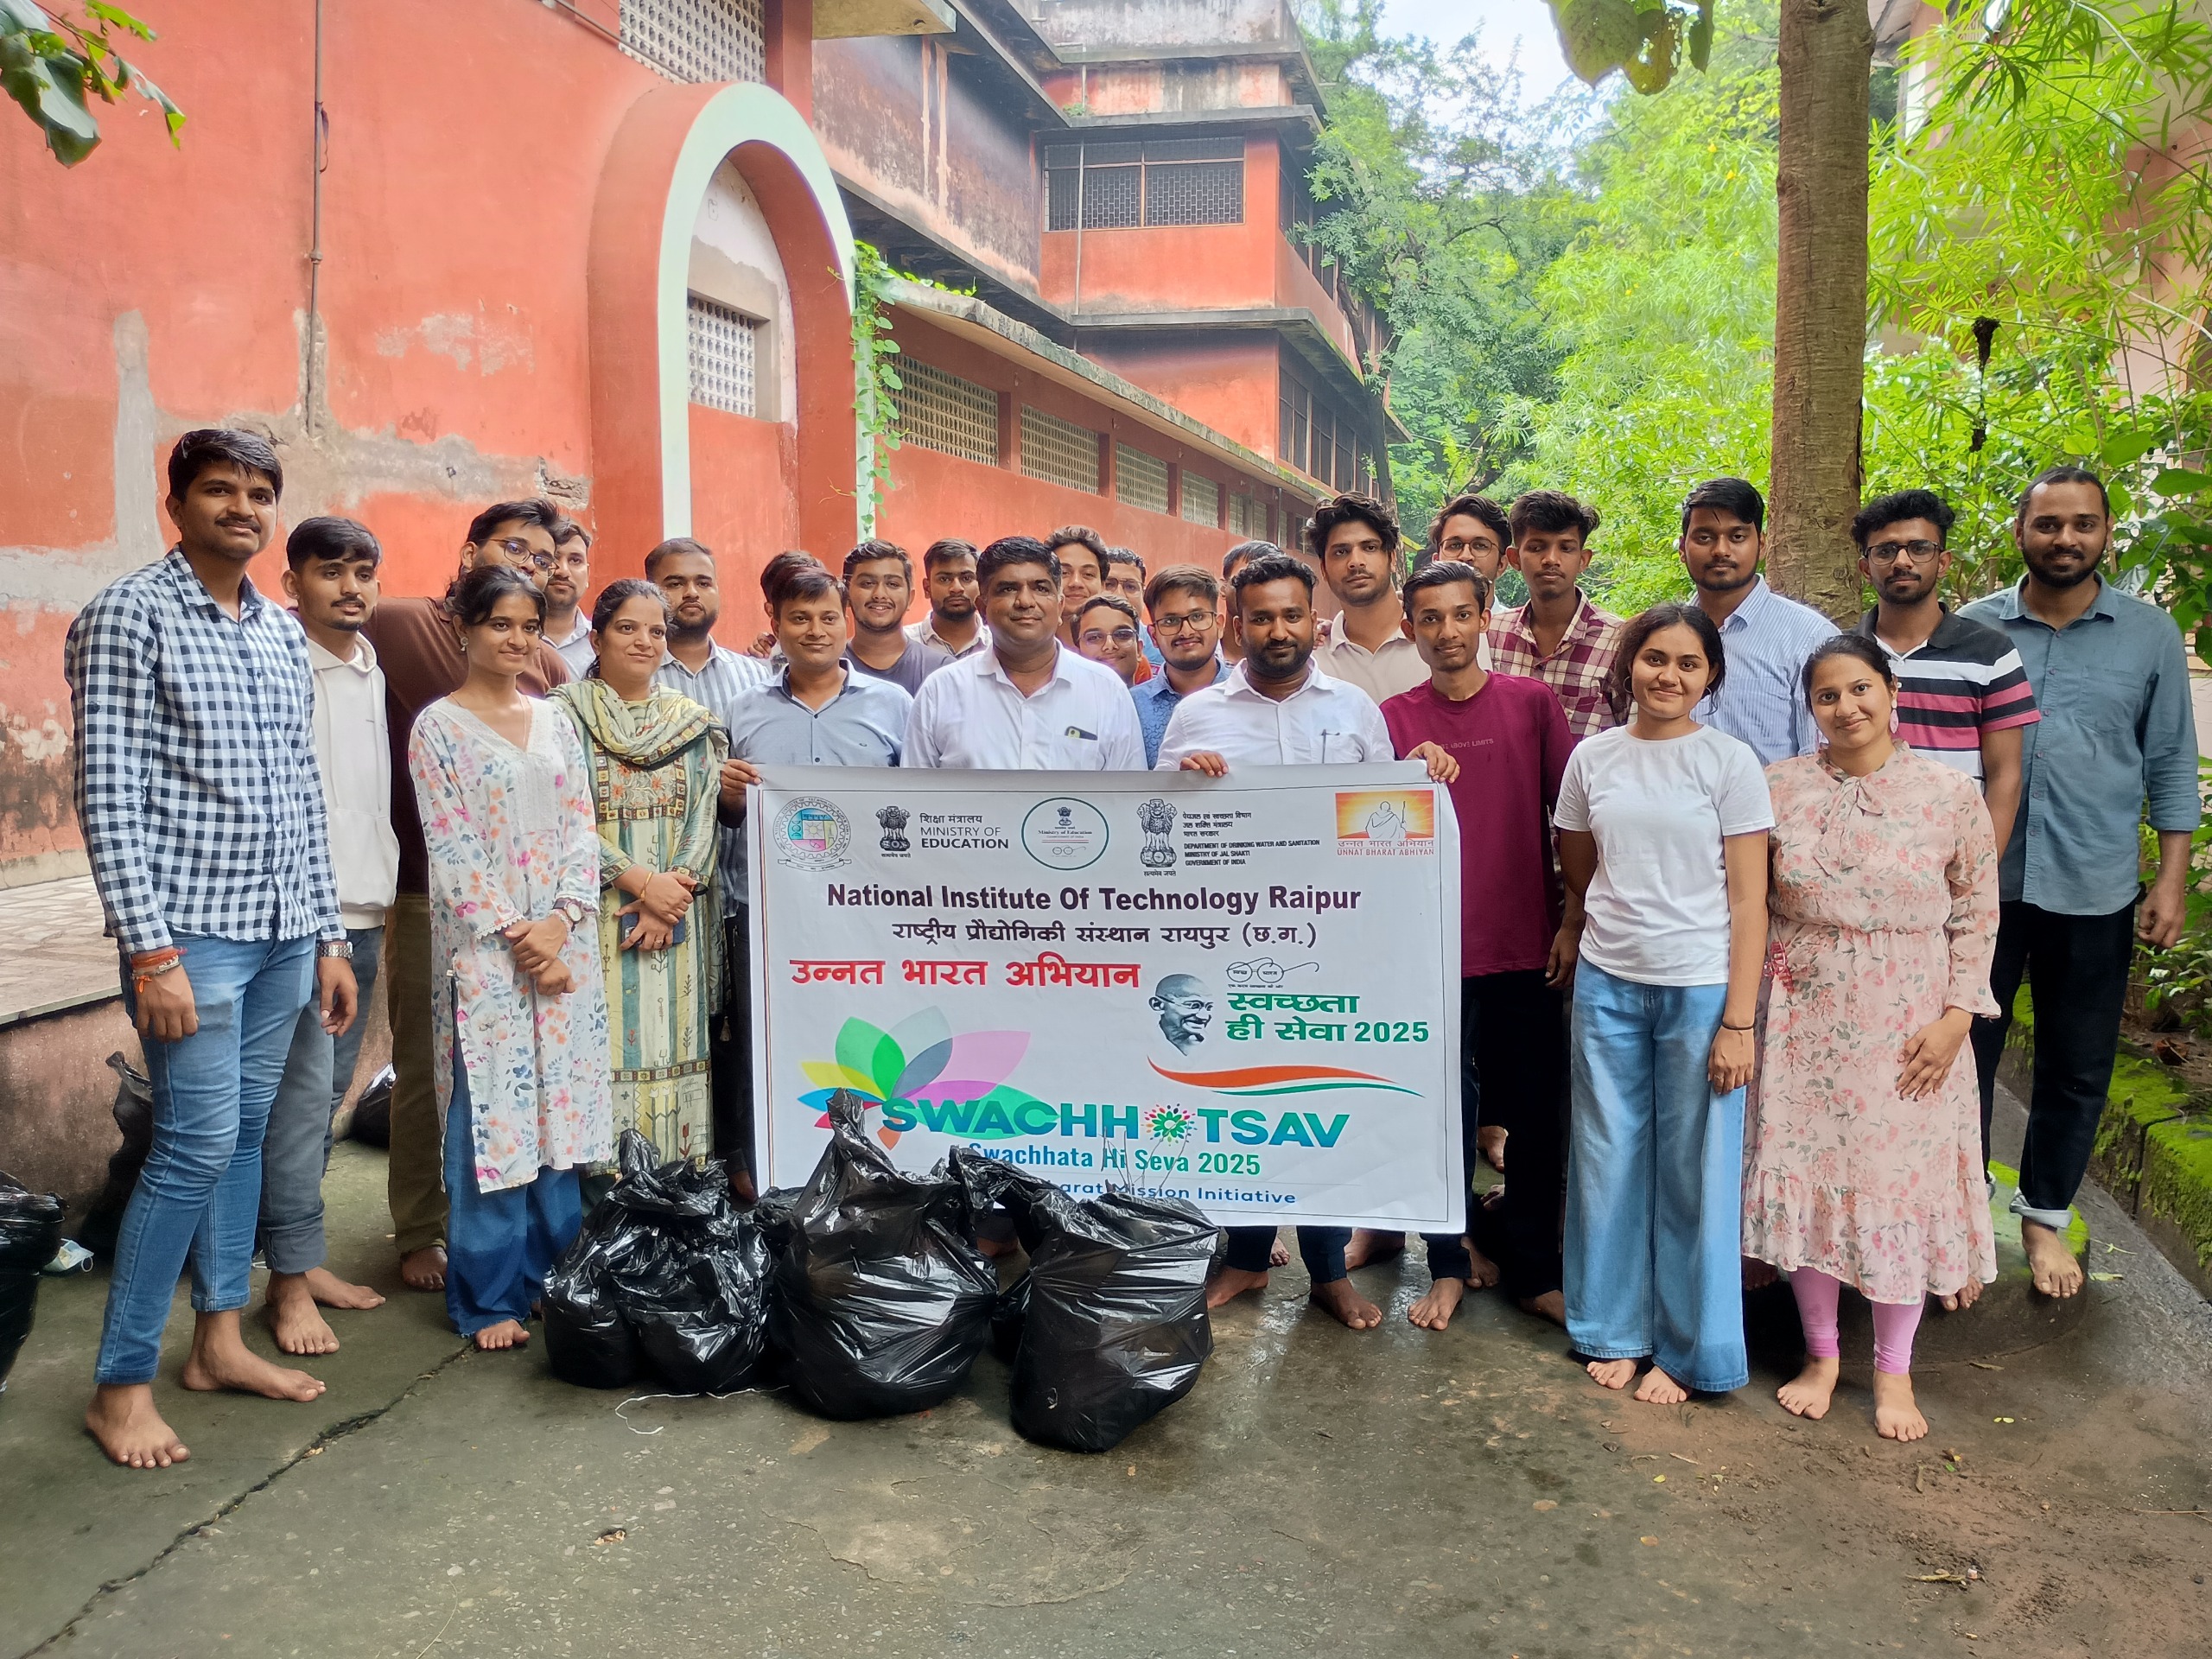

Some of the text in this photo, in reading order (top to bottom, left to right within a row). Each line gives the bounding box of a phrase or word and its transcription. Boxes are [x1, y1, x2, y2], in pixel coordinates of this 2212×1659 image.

[1471, 738, 1494, 747] LIMITS
[919, 813, 982, 823] शिक्षा मंत्रालय
[920, 827, 1001, 836] MINISTRY OF
[921, 838, 1009, 849] EDUCATION
[1397, 838, 1433, 847] अभियान
[828, 884, 1362, 915] National Institute Of Technology Raipur
[892, 918, 1317, 950] राष्ट्रीय प्रौद्योगिकी संस्थान रायपुर (छ.ग.)
[790, 951, 1141, 988] उन्नत भारत अभियान
[1226, 993, 1360, 1014] स्वच्छता
[1225, 1014, 1429, 1043] ही सेवा 2025
[1103, 1147, 1125, 1169] Hi
[1135, 1149, 1189, 1172] Seva
[1198, 1152, 1261, 1175] 2025
[1061, 1182, 1296, 1204] arat Mission Initiative
